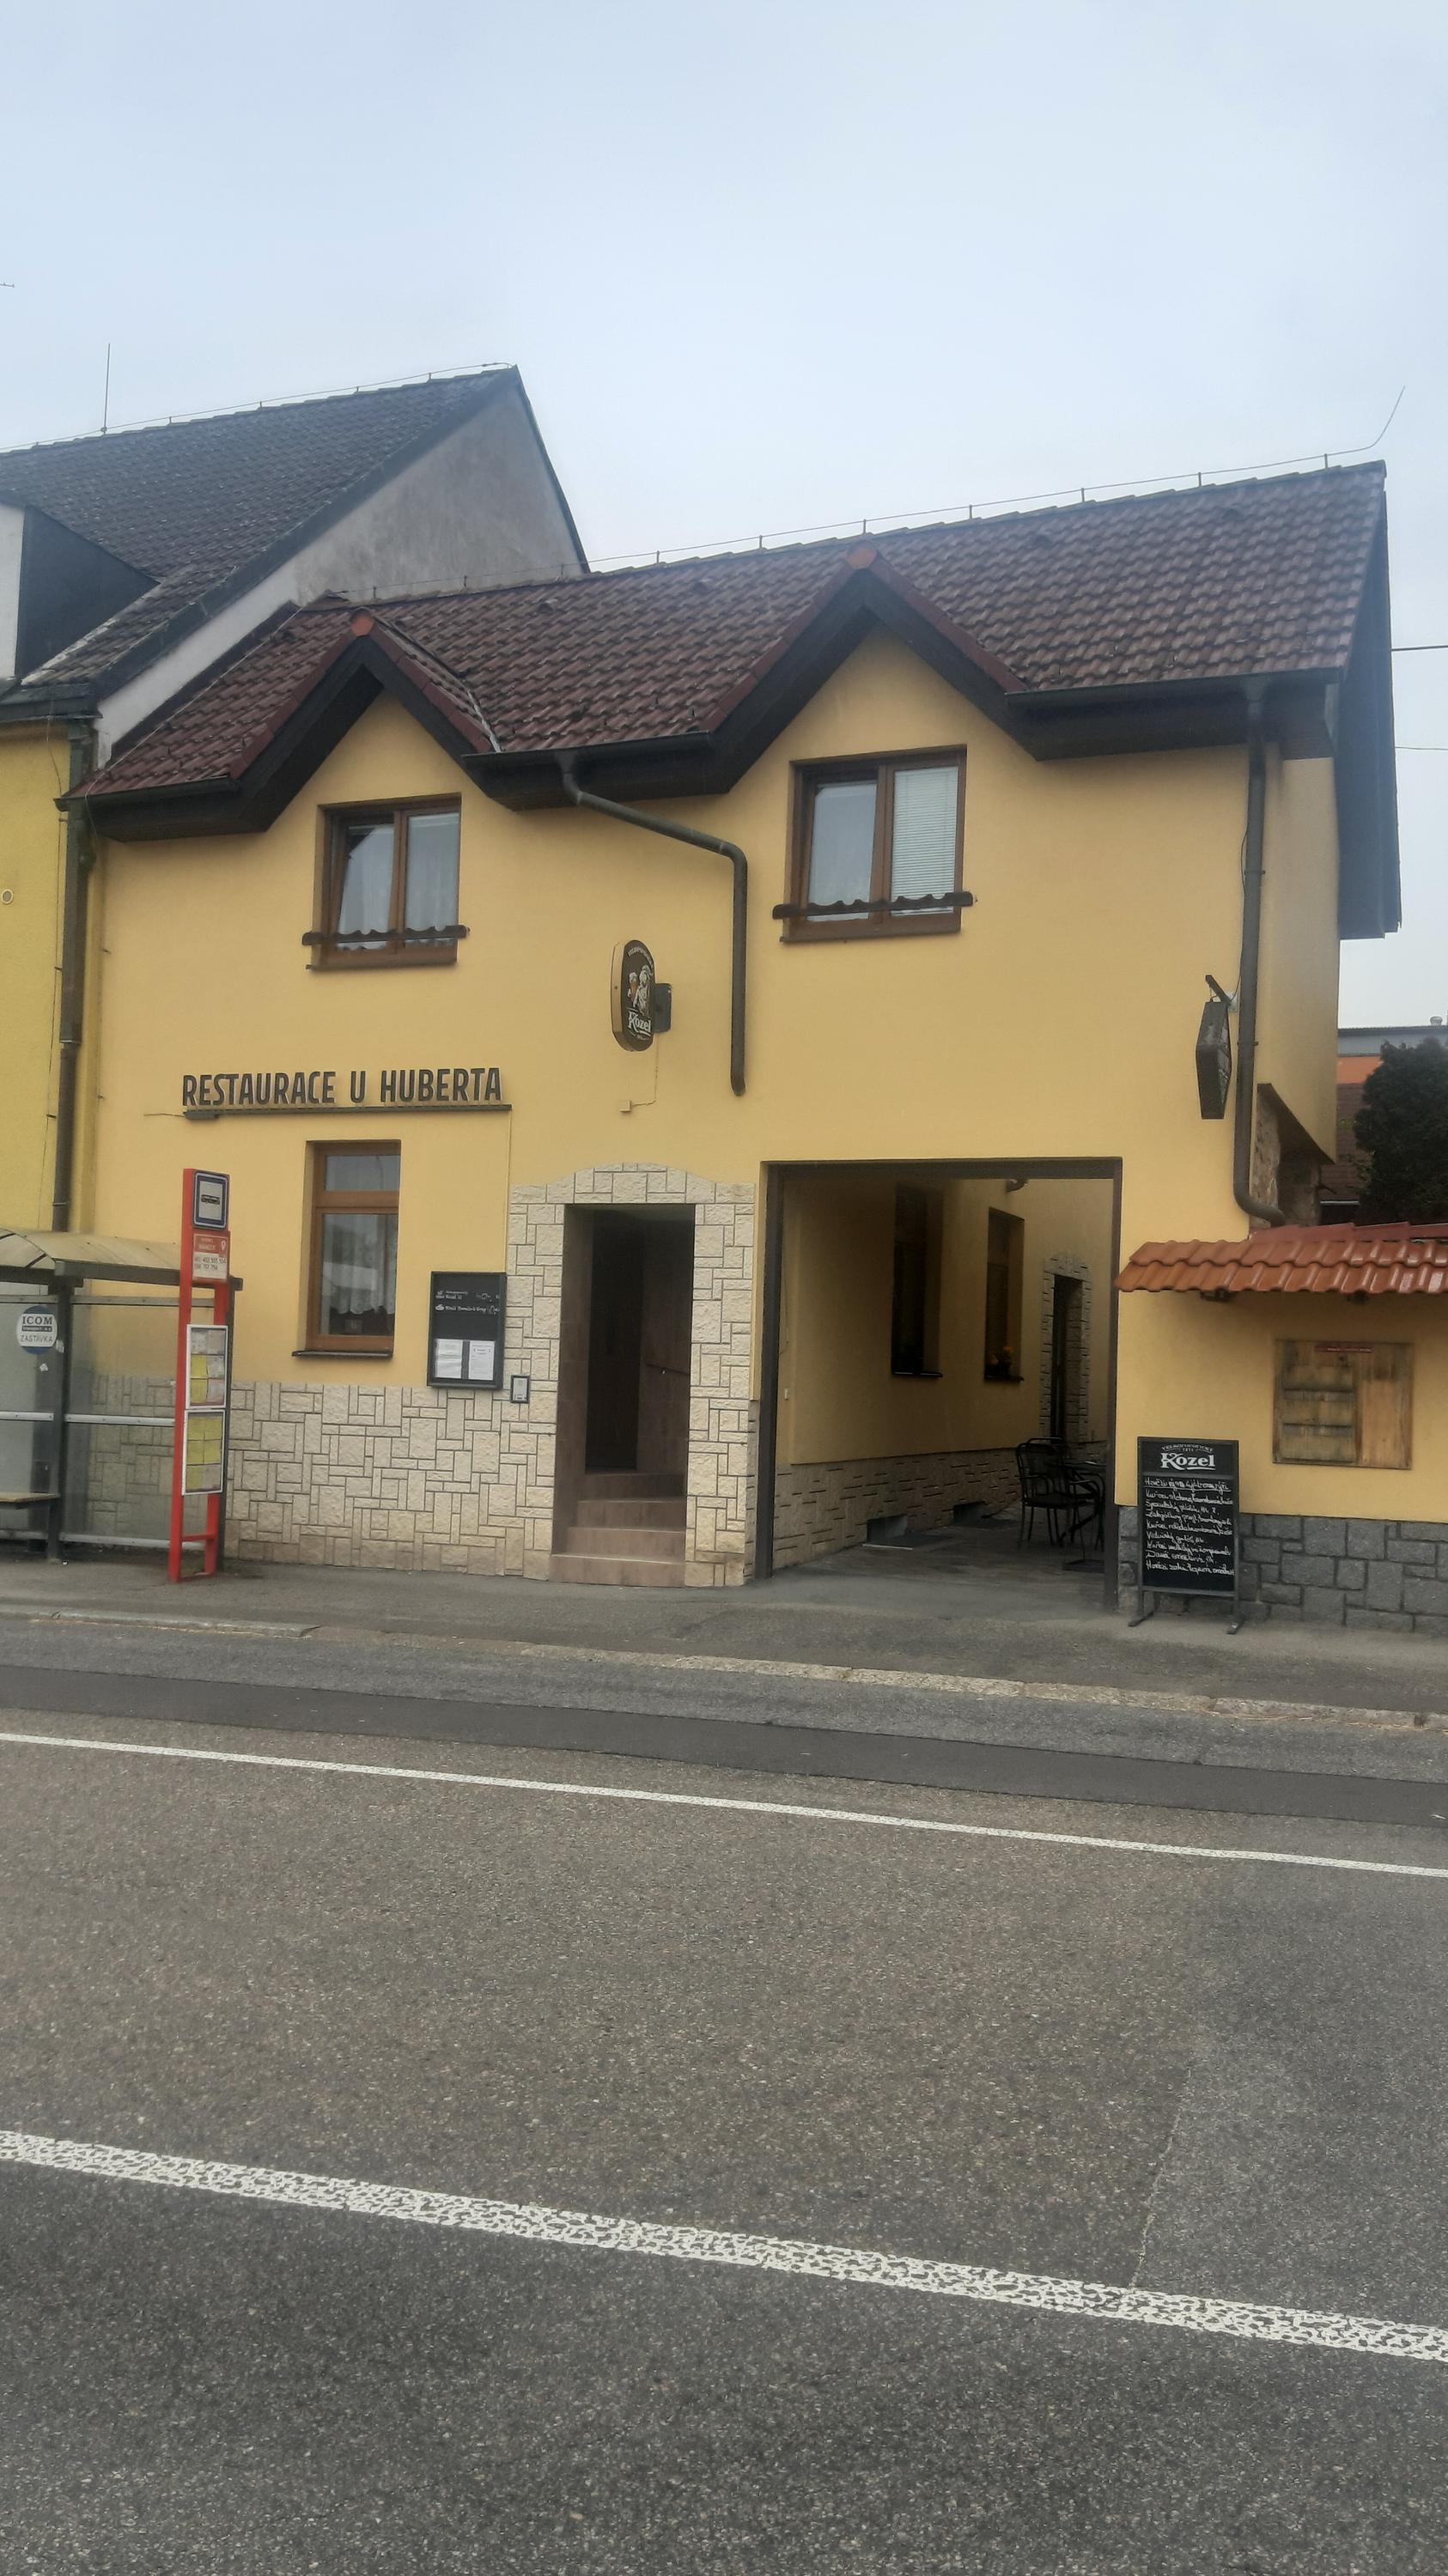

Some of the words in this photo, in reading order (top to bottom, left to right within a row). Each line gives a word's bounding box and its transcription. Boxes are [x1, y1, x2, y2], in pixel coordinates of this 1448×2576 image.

[628, 1011, 653, 1036] Kozel
[182, 1071, 337, 1106] RESTAURACE
[350, 1070, 367, 1103] U
[380, 1067, 502, 1103] HUBERTA
[22, 1315, 52, 1325] ICOM
[1160, 1452, 1216, 1471] Kozel
